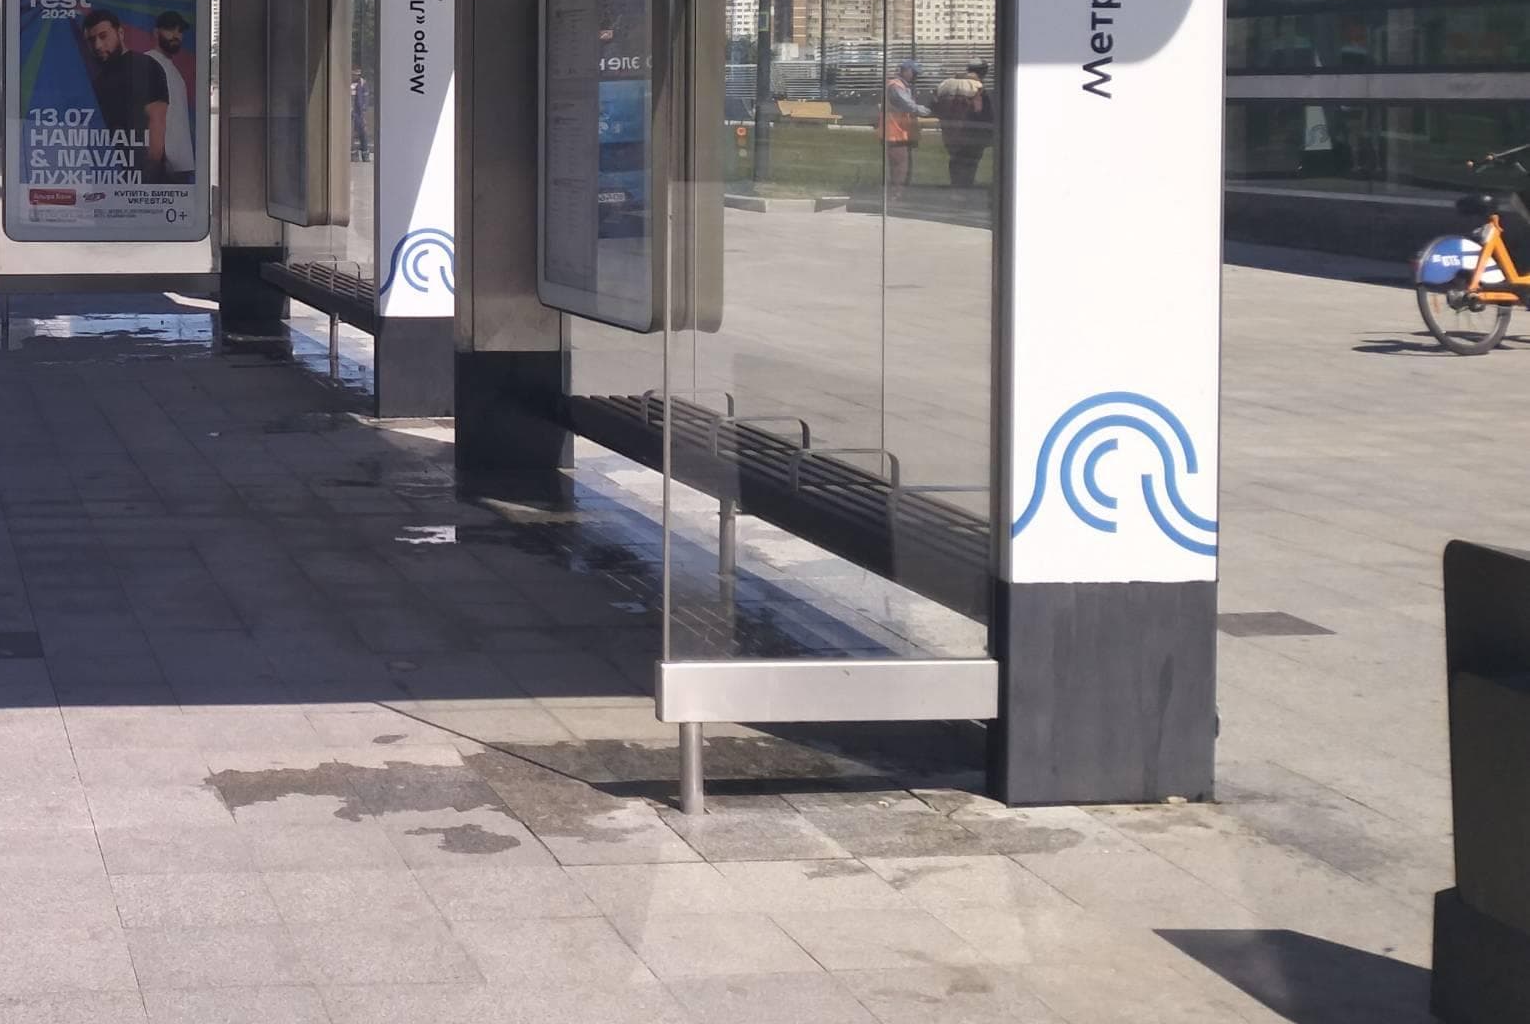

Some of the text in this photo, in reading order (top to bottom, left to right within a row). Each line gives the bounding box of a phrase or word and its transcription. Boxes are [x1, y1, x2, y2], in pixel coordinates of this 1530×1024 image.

[41, 9, 76, 19] 2024
[410, 30, 428, 95] Метро
[29, 108, 95, 127] 13.07
[30, 128, 150, 147] HAMMALI
[30, 149, 135, 167] & NAVAI
[29, 169, 142, 184] ЛУЖНИКИ
[166, 208, 188, 223] 0+
